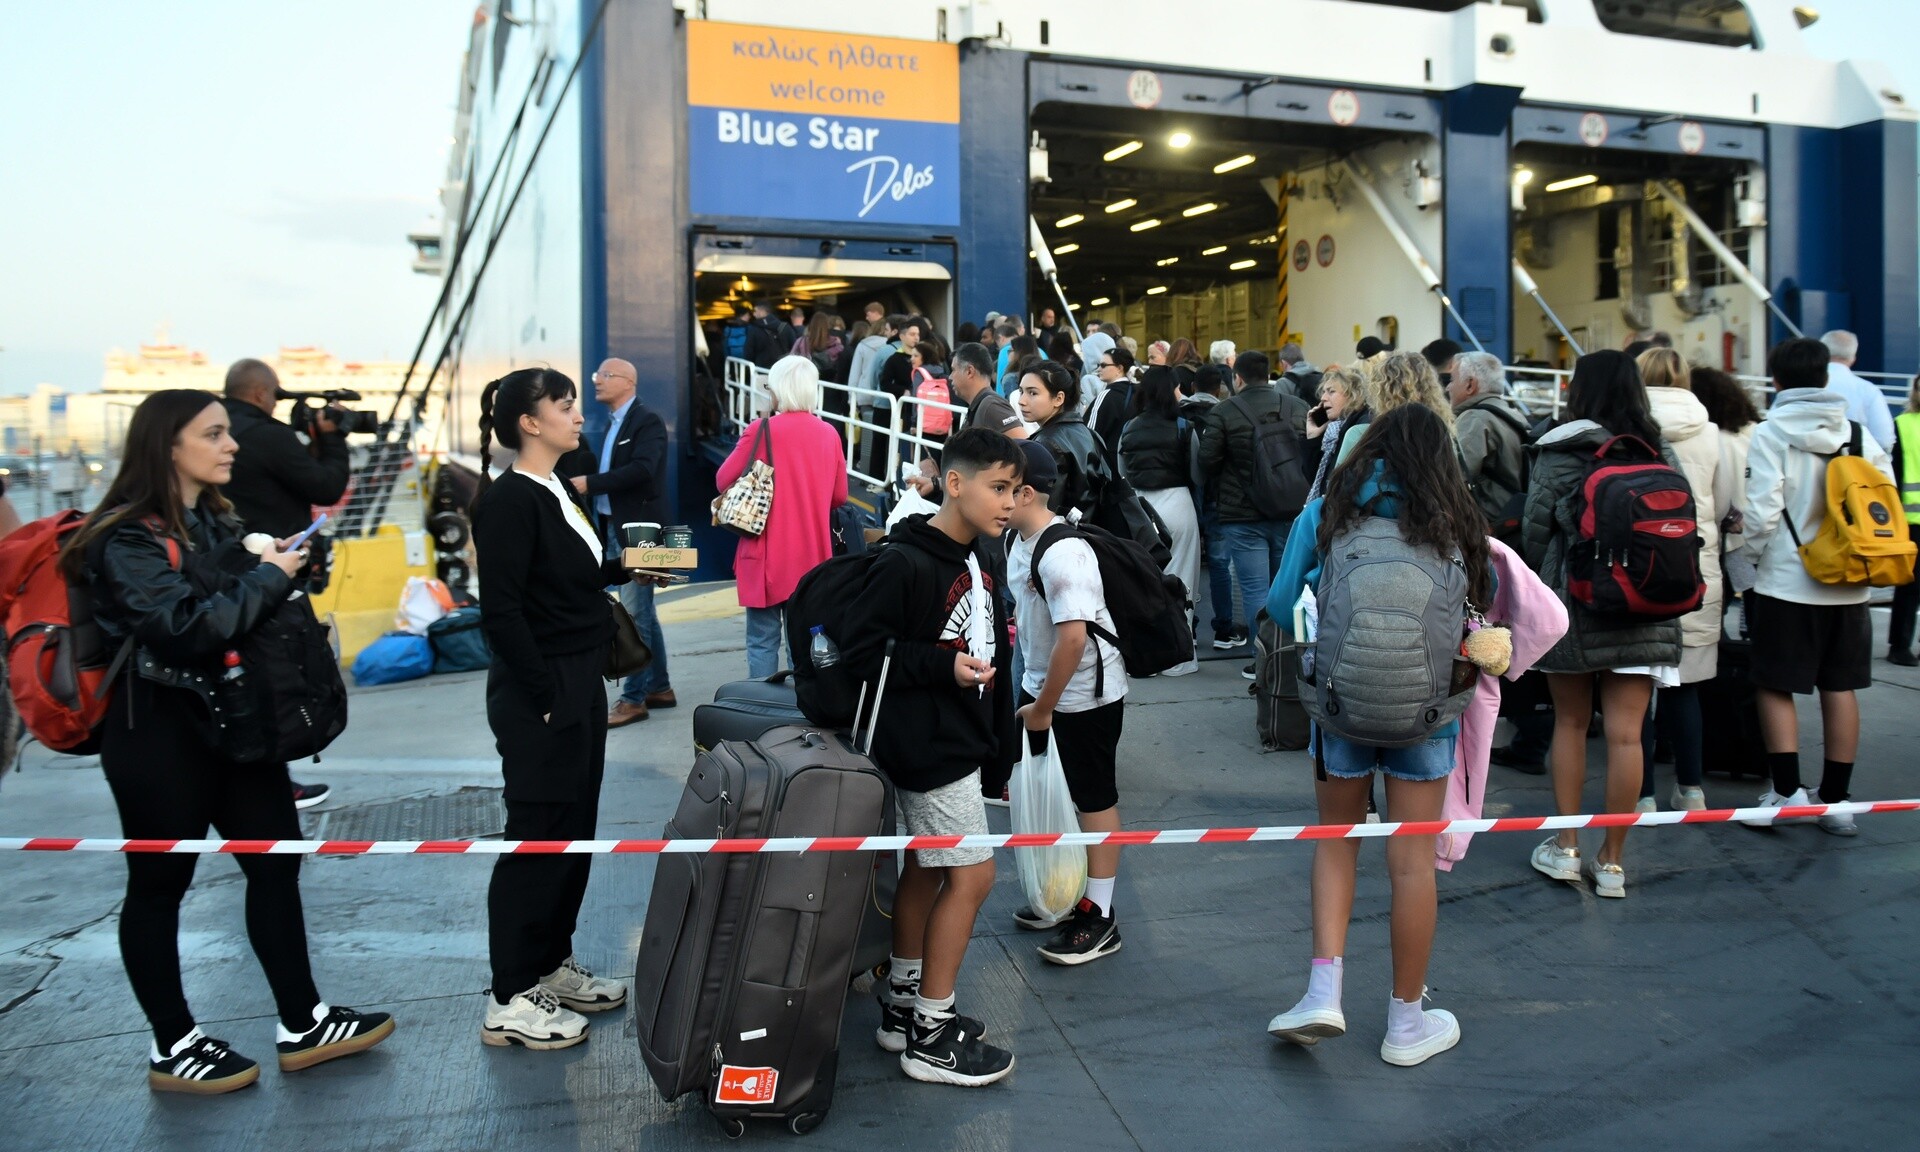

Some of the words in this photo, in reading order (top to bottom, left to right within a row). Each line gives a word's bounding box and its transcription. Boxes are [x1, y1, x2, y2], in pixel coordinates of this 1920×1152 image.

[769, 79, 886, 106] welcome
[718, 110, 799, 148] Blue
[808, 116, 880, 152] Star
[846, 155, 935, 218] Delos
[763, 1070, 773, 1099] FRAGILE
